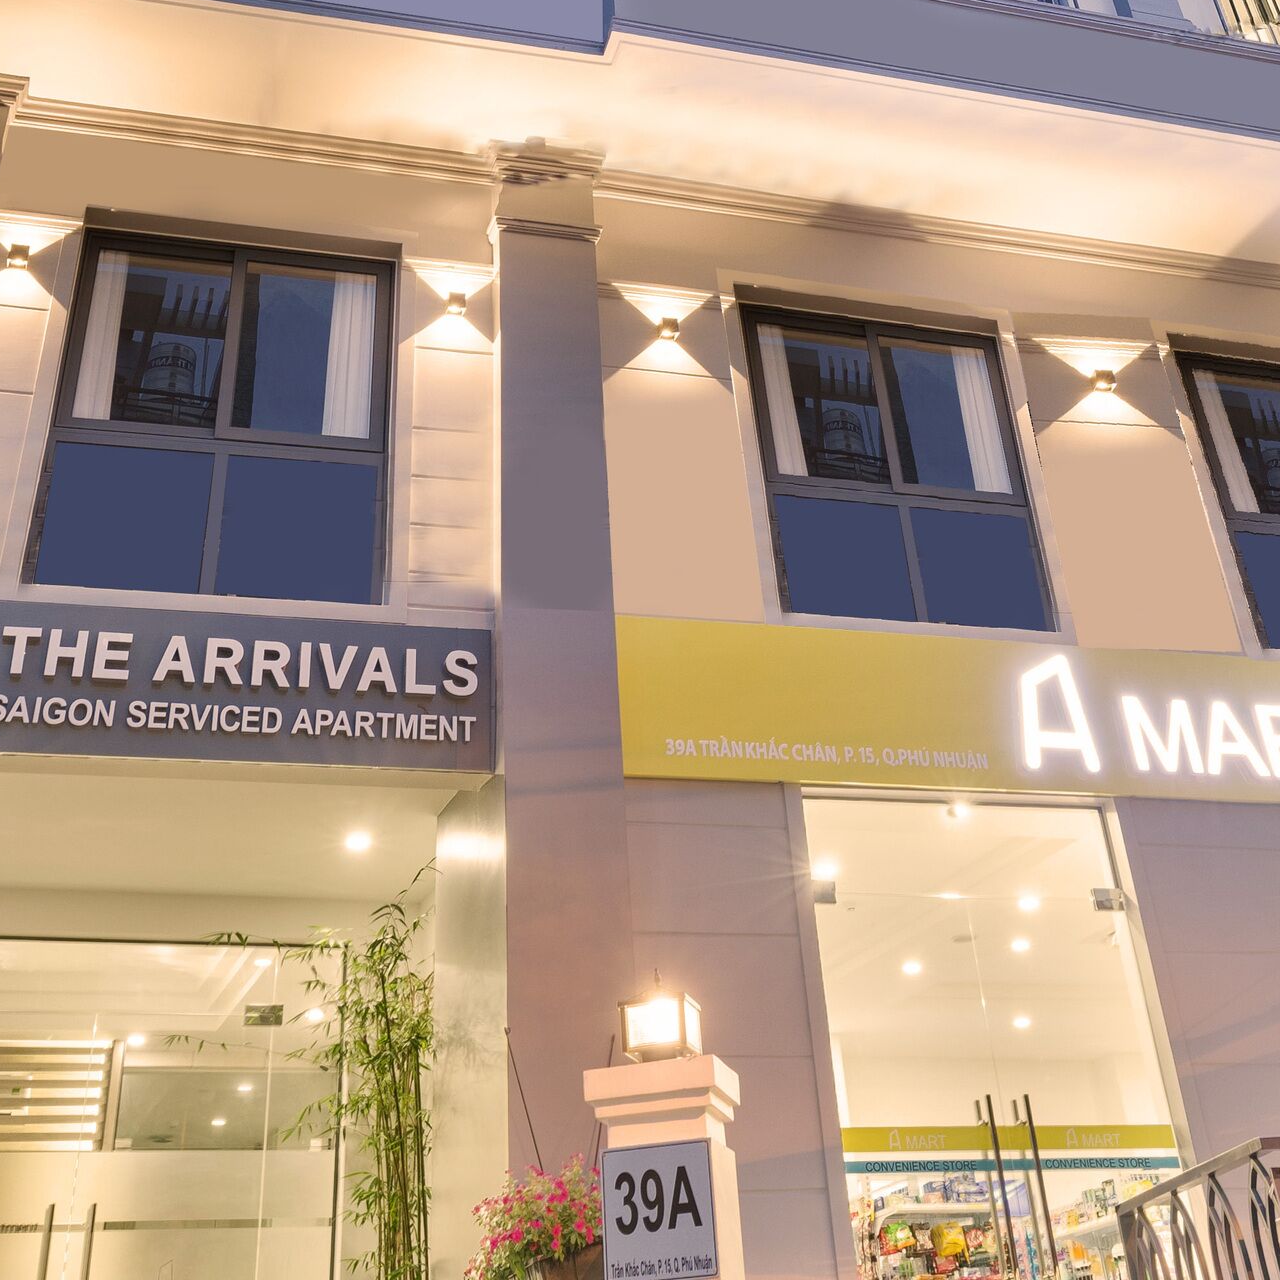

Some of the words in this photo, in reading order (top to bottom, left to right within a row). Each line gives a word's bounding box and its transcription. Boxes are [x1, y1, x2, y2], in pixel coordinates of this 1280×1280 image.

[2, 625, 134, 681] THE
[151, 634, 479, 698] ARRIVALS
[126, 699, 282, 735] SERVICED
[291, 706, 477, 744] APARTMENT
[1020, 653, 1102, 773] A
[665, 738, 697, 758] 39A
[698, 735, 743, 759] TRẦN
[791, 741, 841, 766] CHÂN,
[844, 745, 857, 763] P.
[858, 746, 880, 767] 15,
[933, 749, 989, 773] NHUẬN
[906, 1134, 948, 1150] MART
[1082, 1133, 1121, 1147] MART
[865, 1160, 940, 1173] CONVENIENCE
[943, 1160, 977, 1171] STORE
[1045, 1158, 1117, 1169] CONVENIENCE
[1119, 1157, 1151, 1168] STORE
[614, 1165, 703, 1236] 39A
